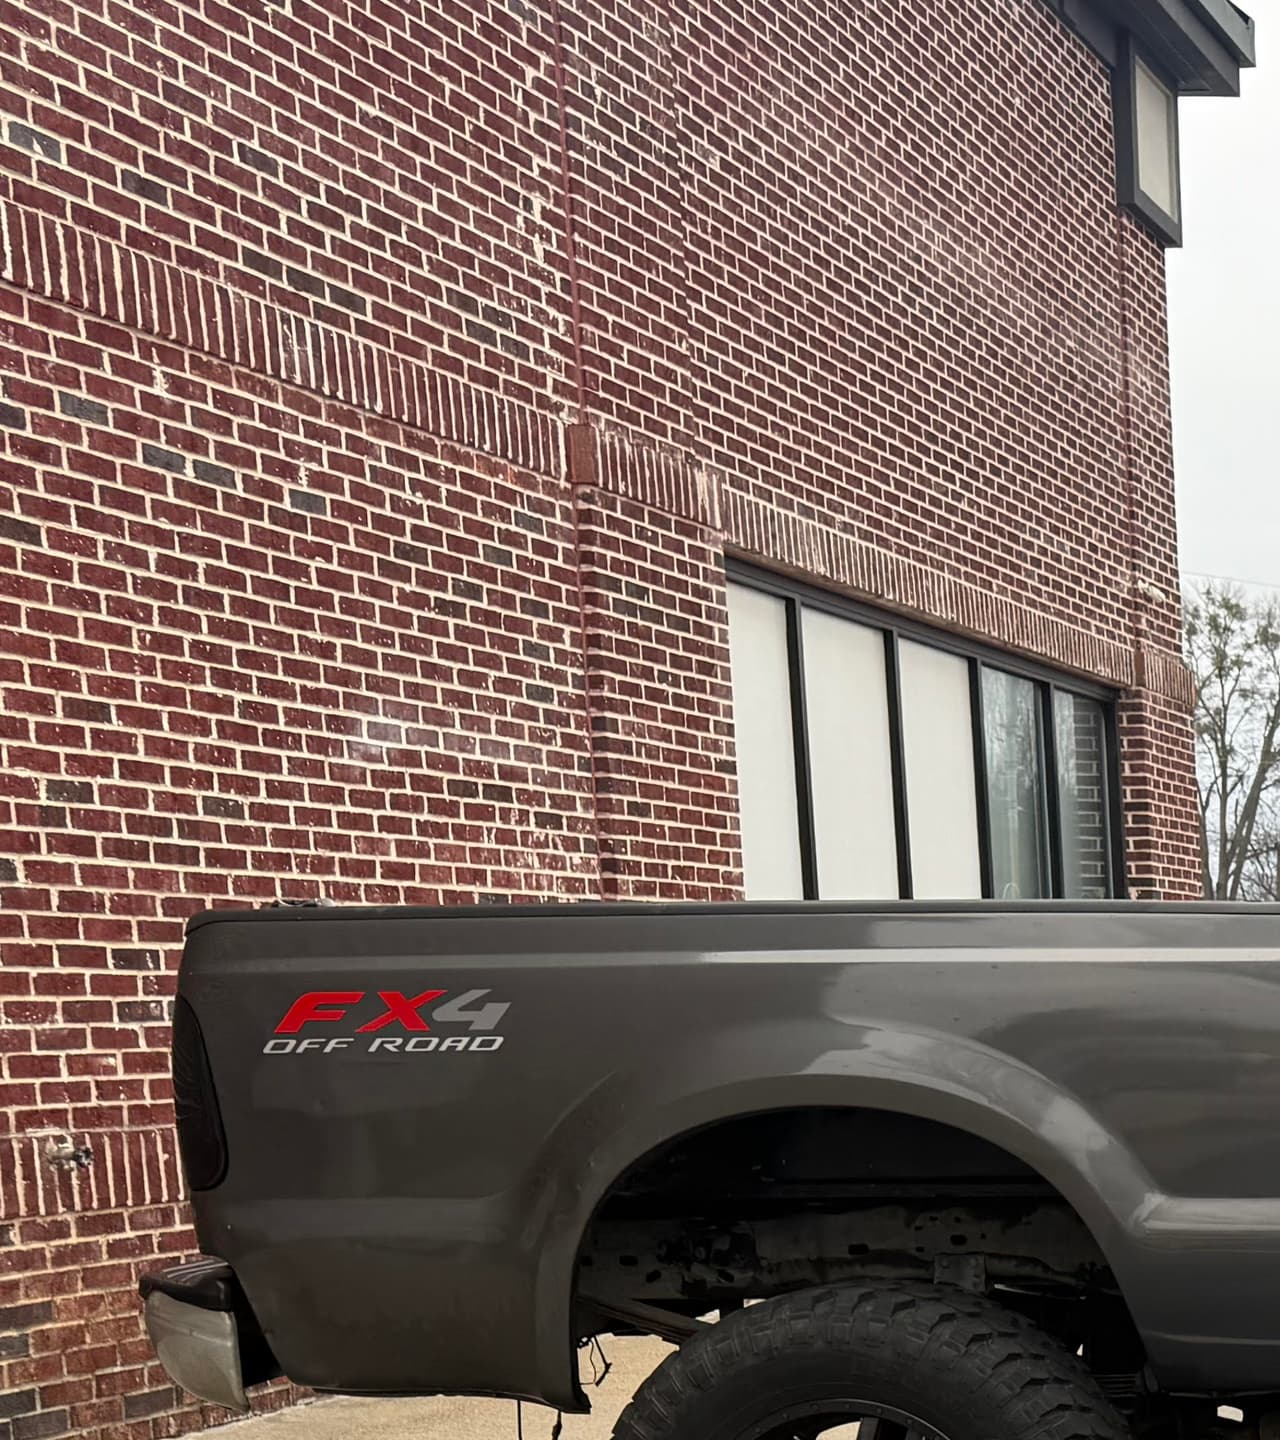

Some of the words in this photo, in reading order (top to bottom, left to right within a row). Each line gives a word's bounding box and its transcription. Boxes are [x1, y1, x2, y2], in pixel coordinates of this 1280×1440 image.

[274, 989, 512, 1034] FX4
[262, 1038, 355, 1053] OFF
[367, 1036, 505, 1052] ROAD
